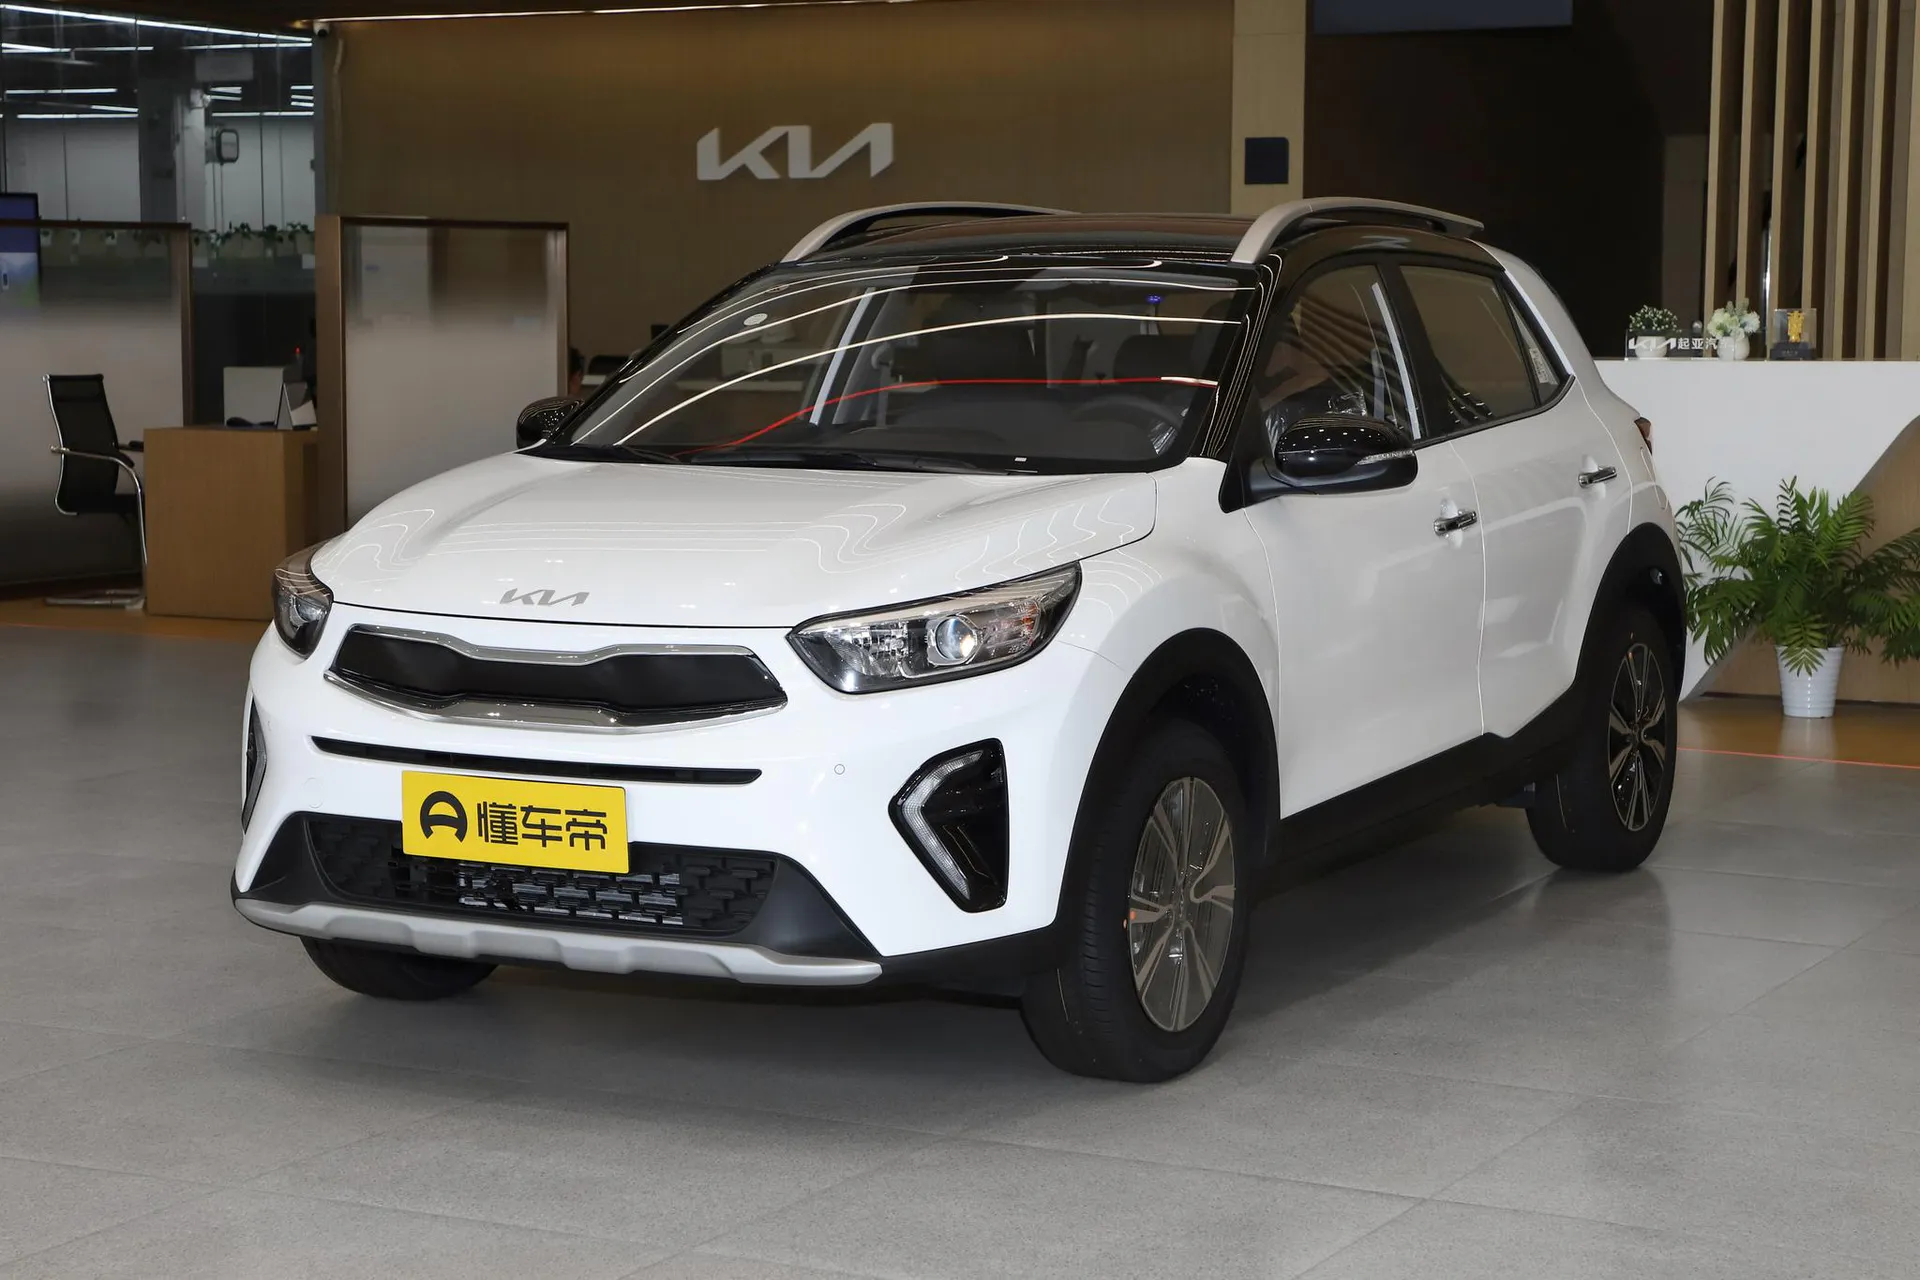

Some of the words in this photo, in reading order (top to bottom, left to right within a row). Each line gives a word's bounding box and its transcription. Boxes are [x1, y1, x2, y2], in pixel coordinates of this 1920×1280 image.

[696, 122, 894, 181] KIA
[500, 588, 590, 606] KIA
[476, 801, 608, 851] 懂车帝
